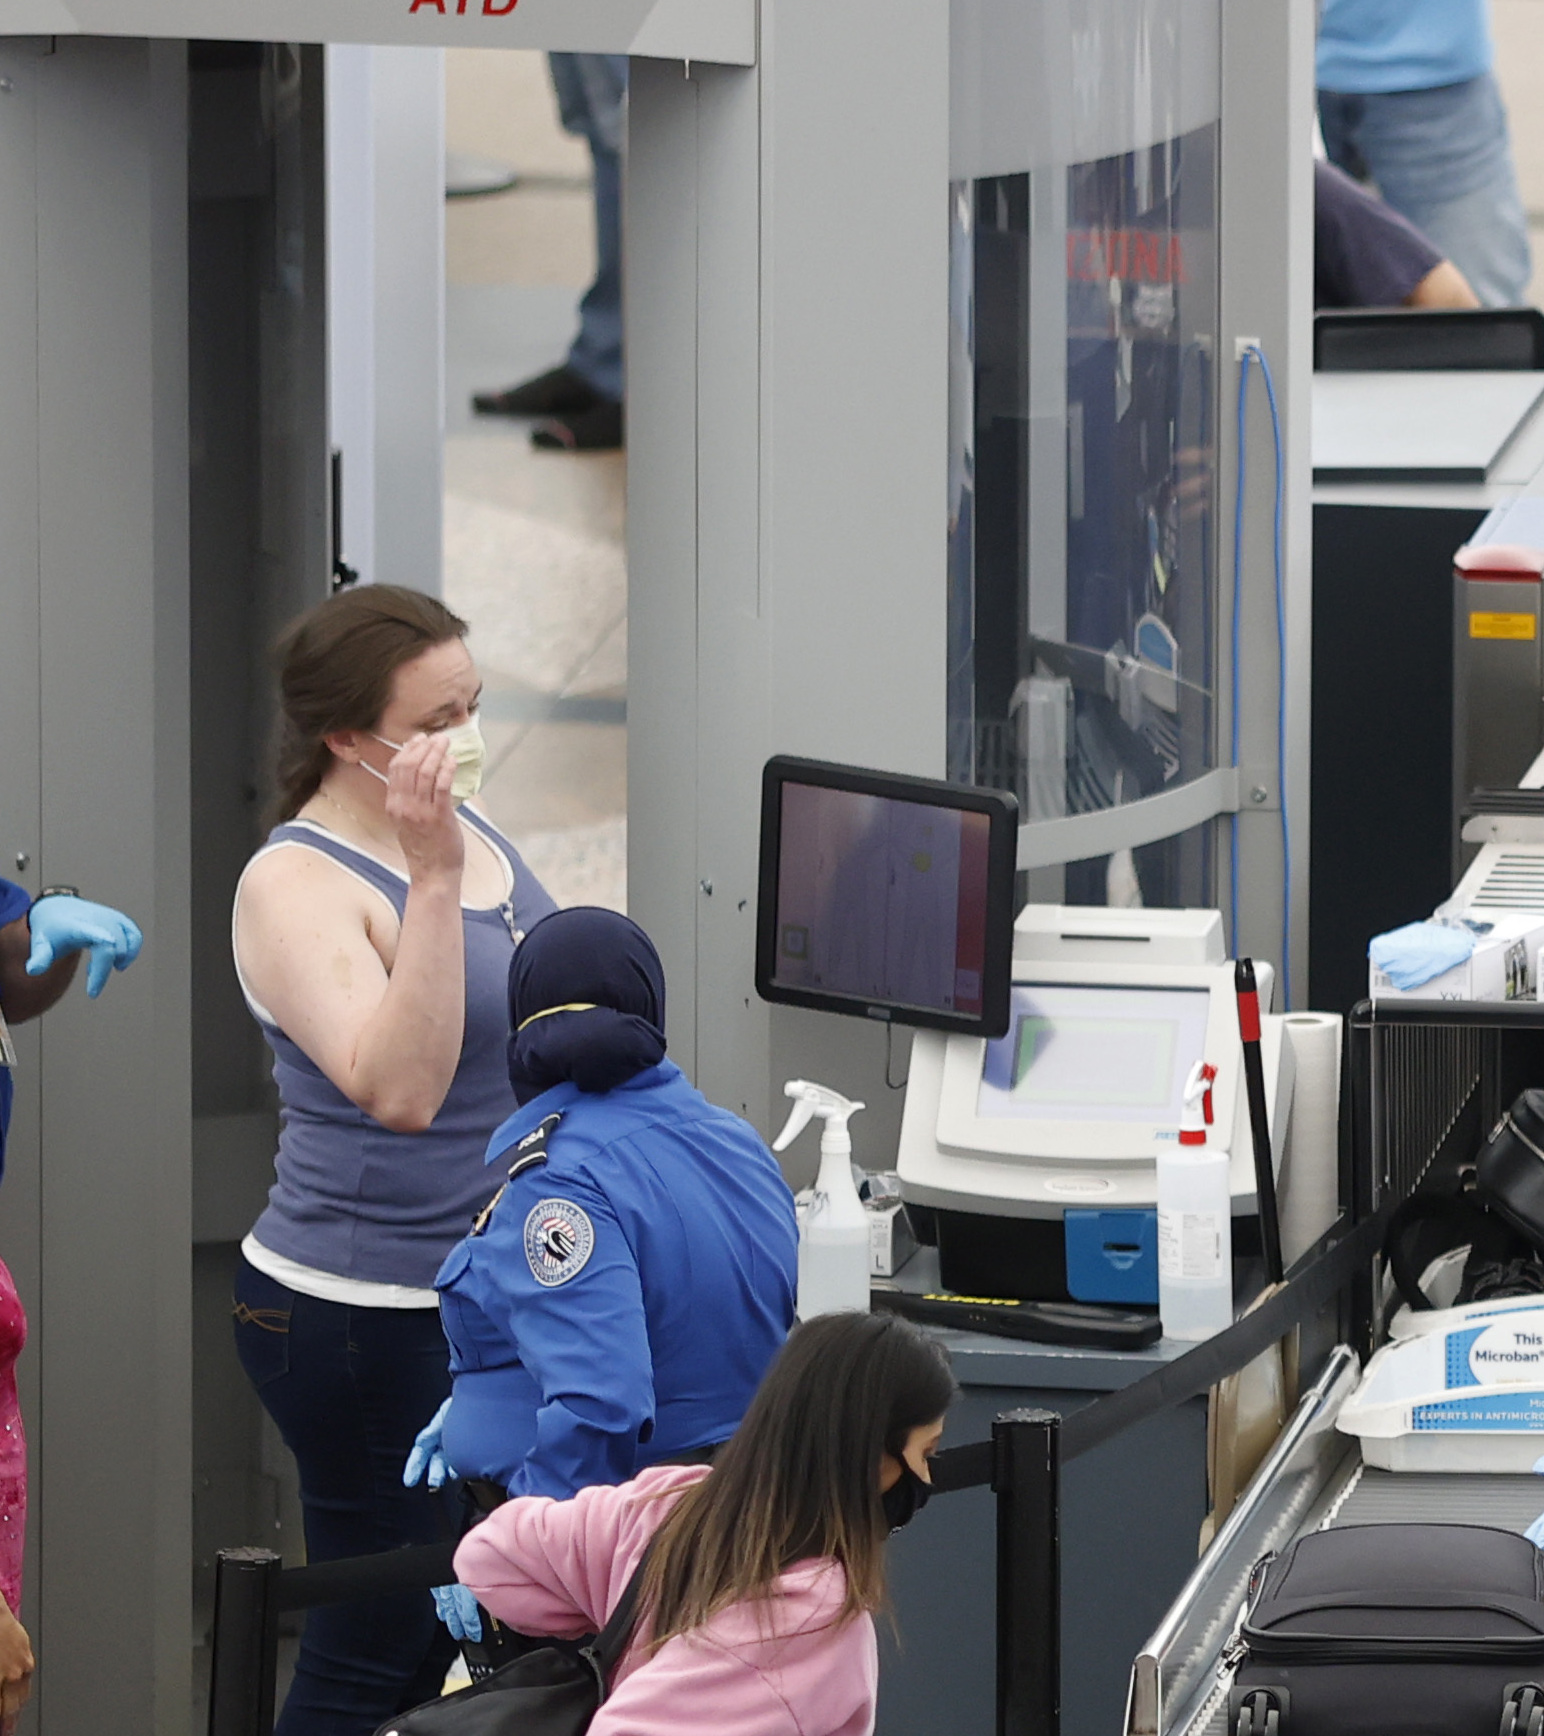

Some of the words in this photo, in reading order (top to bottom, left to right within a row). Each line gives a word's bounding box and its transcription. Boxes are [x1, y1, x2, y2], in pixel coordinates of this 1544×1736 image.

[1514, 1333, 1543, 1347] This
[1419, 1411, 1468, 1421] EXPERTS
[1470, 1412, 1483, 1421] IN
